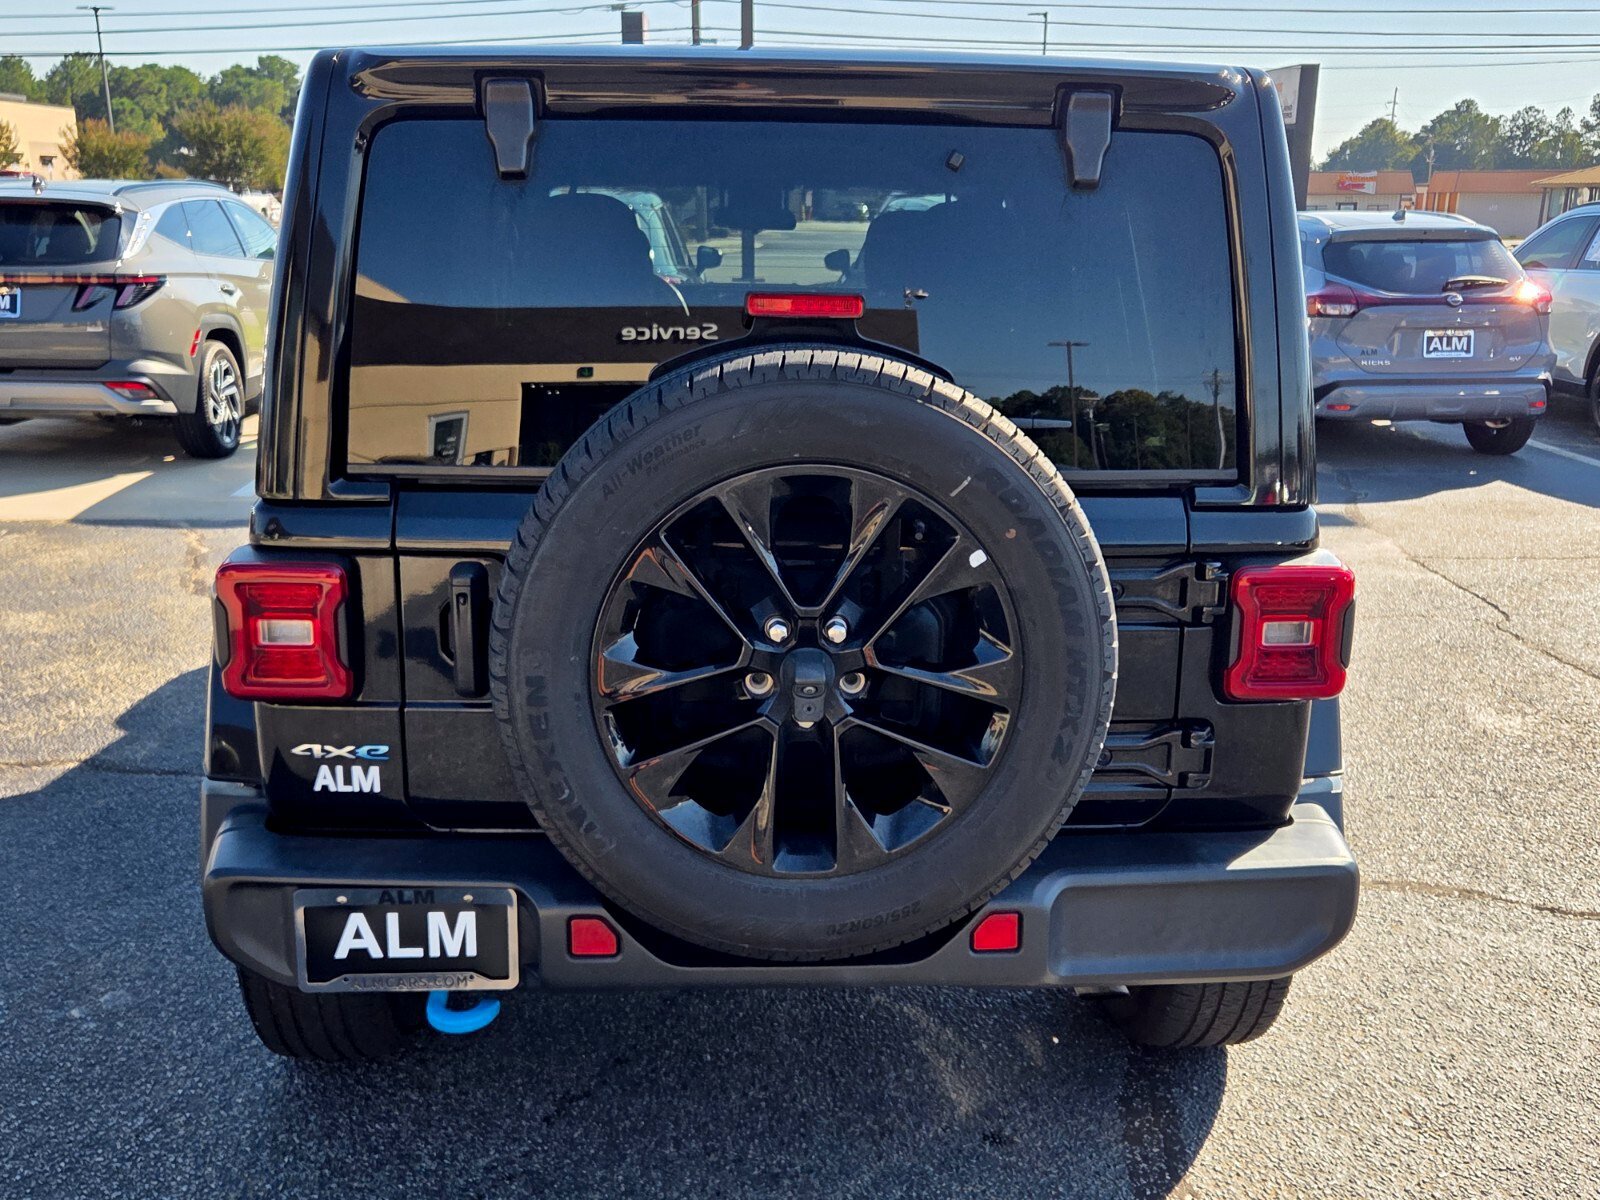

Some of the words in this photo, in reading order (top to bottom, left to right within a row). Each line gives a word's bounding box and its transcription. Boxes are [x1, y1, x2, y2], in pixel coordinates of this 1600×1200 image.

[1429, 337, 1468, 351] ALM
[600, 423, 704, 499] All-Weather
[523, 674, 598, 837] NEXEN
[314, 764, 381, 793] ALM
[378, 889, 436, 905] ALM
[333, 910, 478, 960] ALM
[351, 976, 468, 990] ALMCARS.COM
